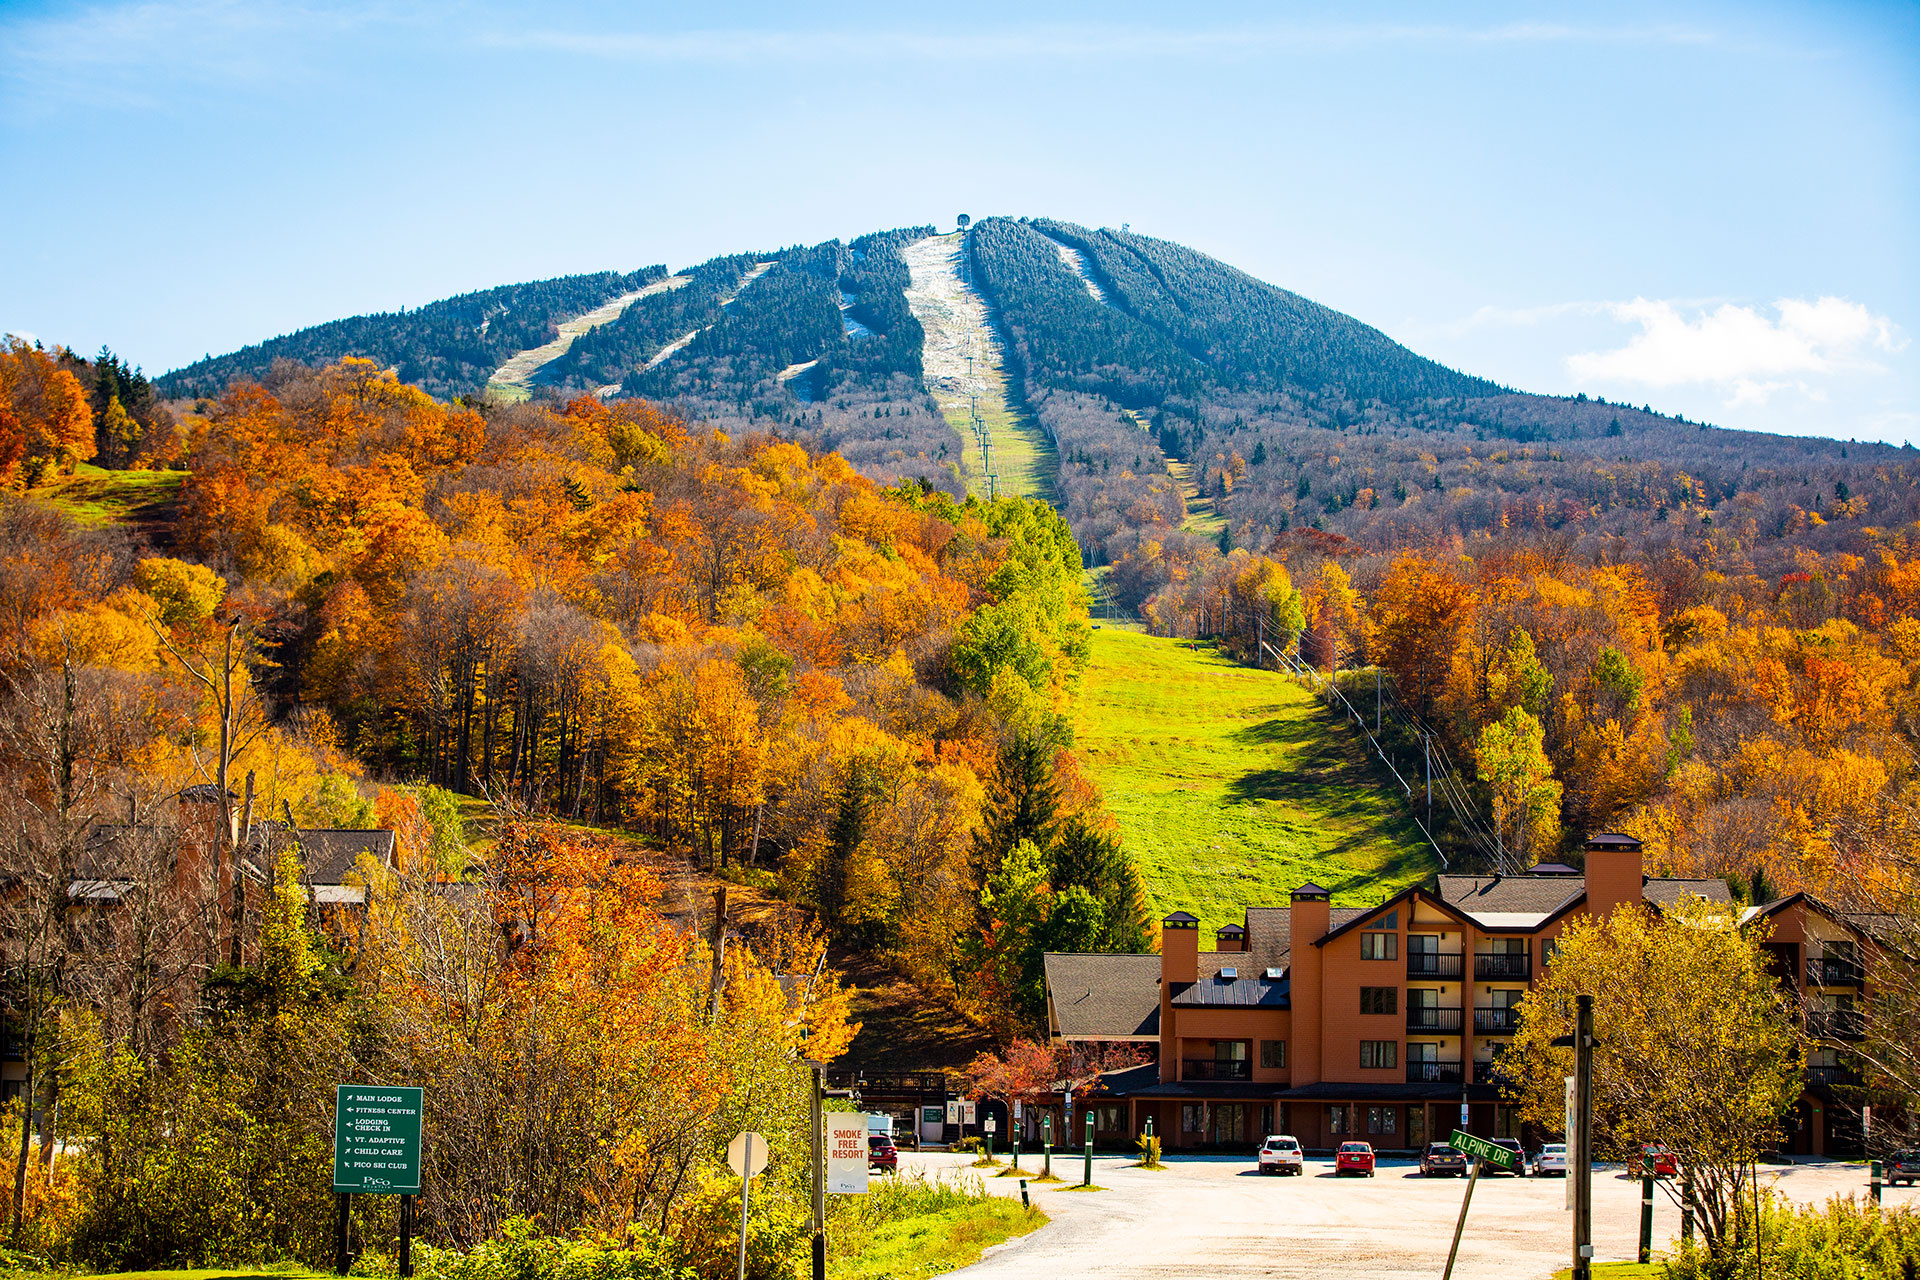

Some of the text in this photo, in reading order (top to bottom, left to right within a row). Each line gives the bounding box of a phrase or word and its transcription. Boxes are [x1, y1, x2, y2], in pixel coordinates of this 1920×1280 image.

[377, 1095, 402, 1103] LODGE
[833, 1130, 862, 1139] SMOKE
[838, 1140, 858, 1149] FREE
[1453, 1134, 1510, 1165] ALPINE DR
[832, 1150, 864, 1159] RESORT
[388, 1162, 408, 1170] CLUB
